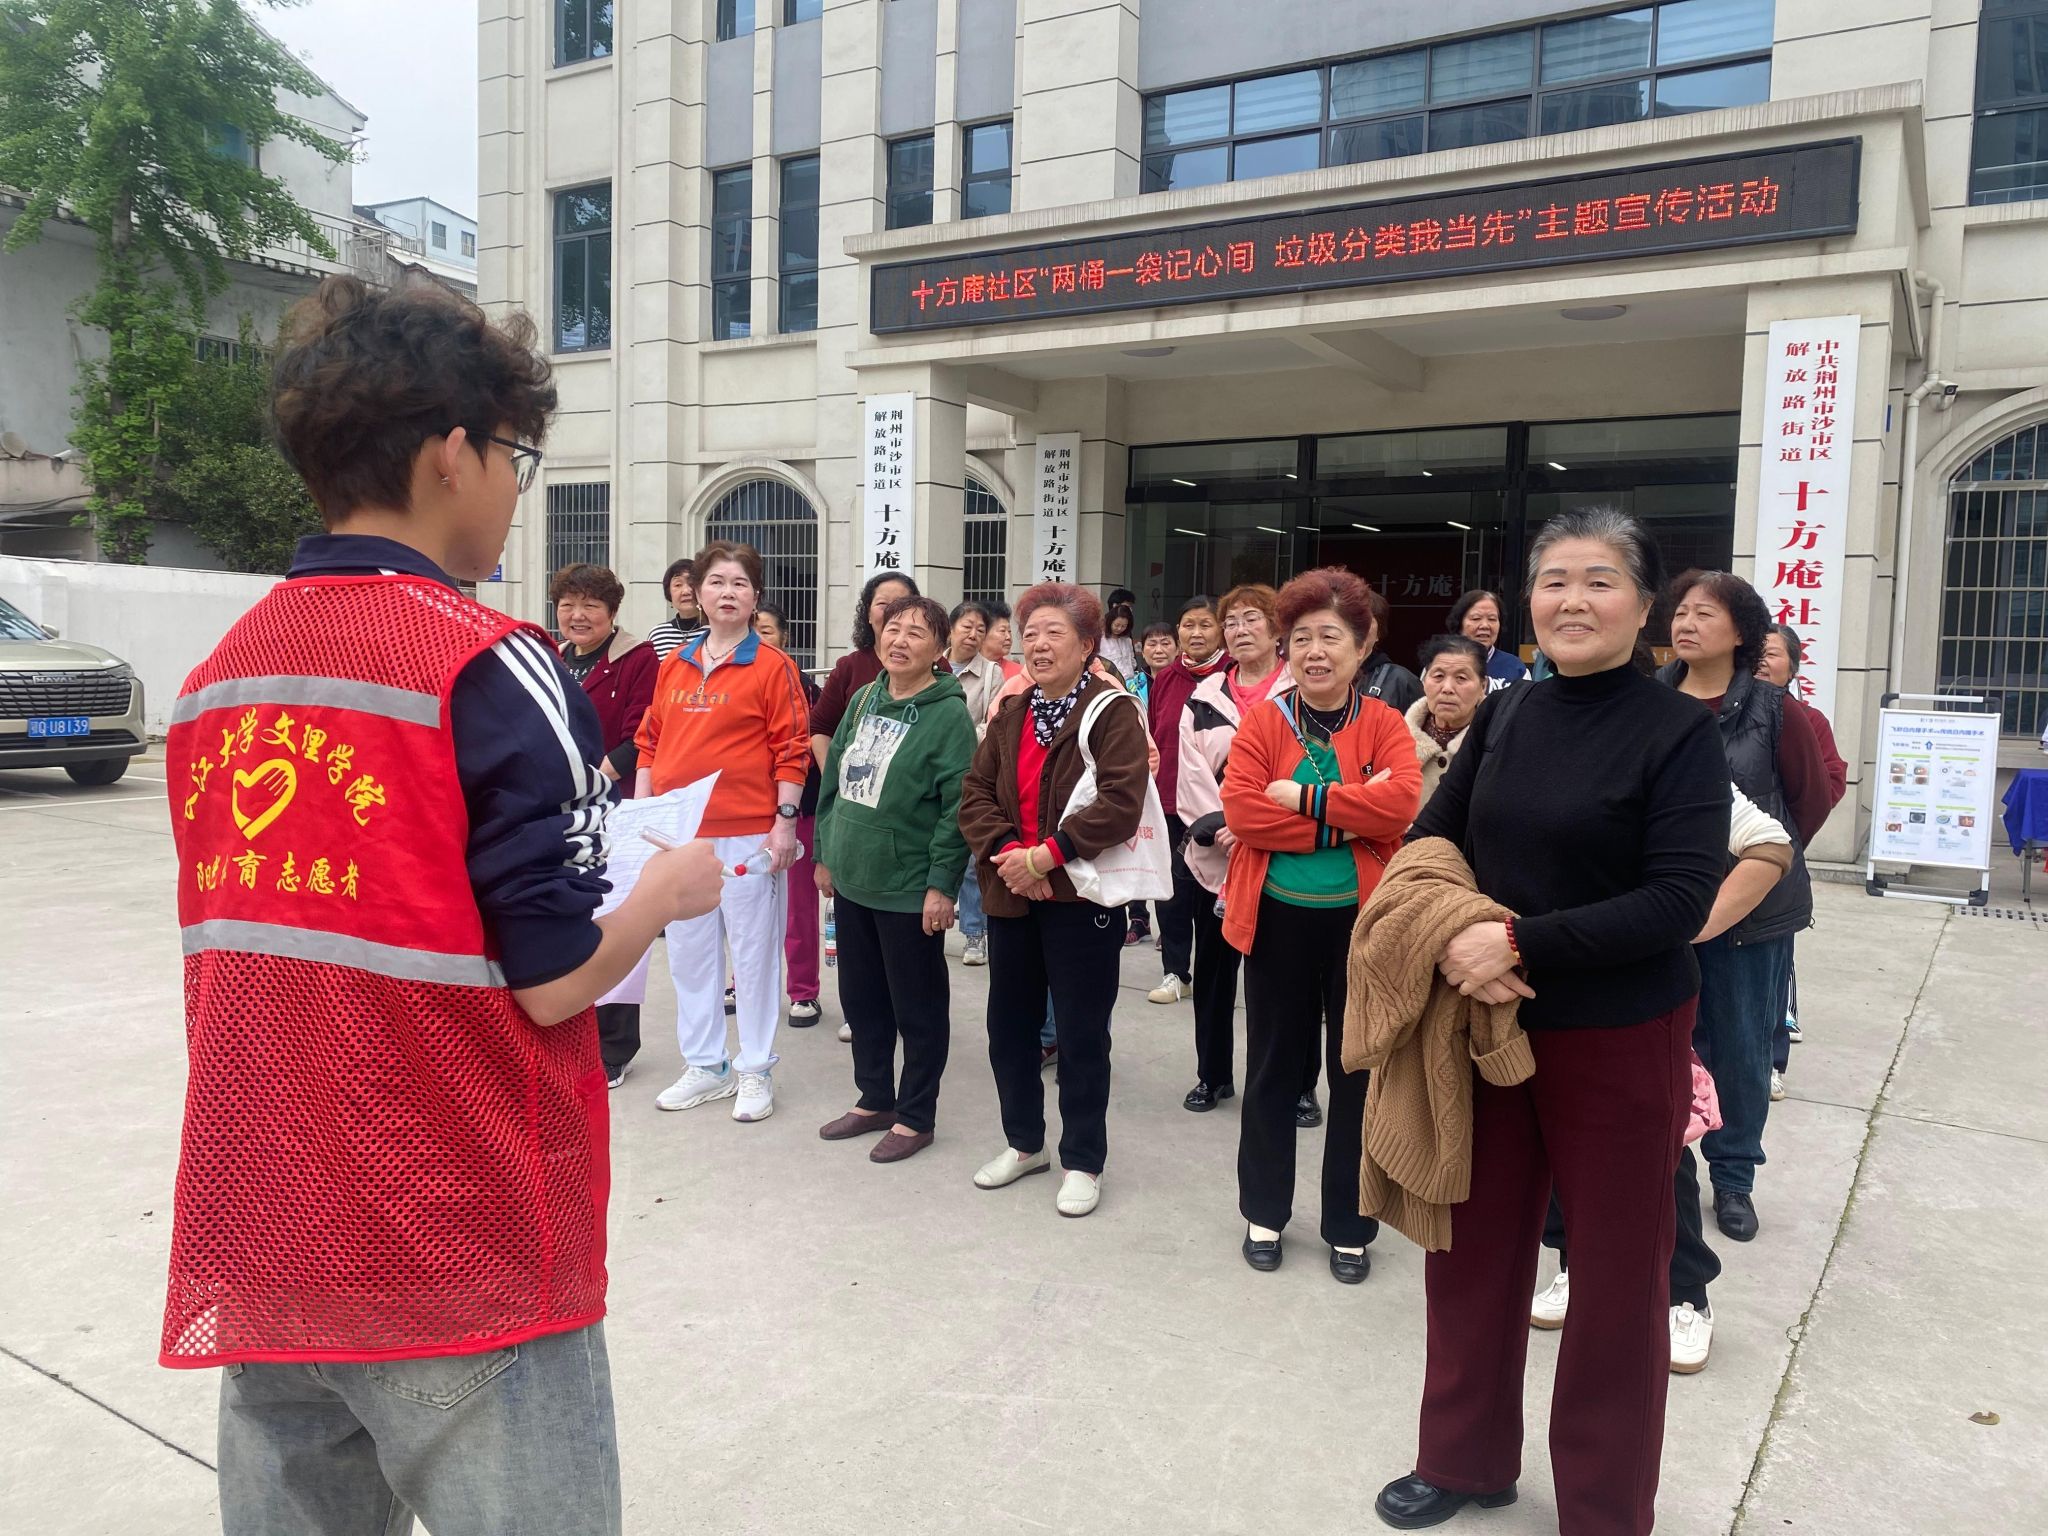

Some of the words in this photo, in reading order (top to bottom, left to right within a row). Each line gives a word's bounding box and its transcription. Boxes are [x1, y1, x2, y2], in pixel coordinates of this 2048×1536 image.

[1779, 341, 1811, 462] 解放路街道
[1809, 339, 1840, 461] 中共荆州市沙市区
[873, 411, 887, 490] 解放路街道
[889, 409, 903, 489] 荆州市沙市区
[1043, 449, 1056, 518] 解放路街道
[1057, 448, 1071, 517] 荆州市沙市区
[873, 504, 901, 569] 十方庵
